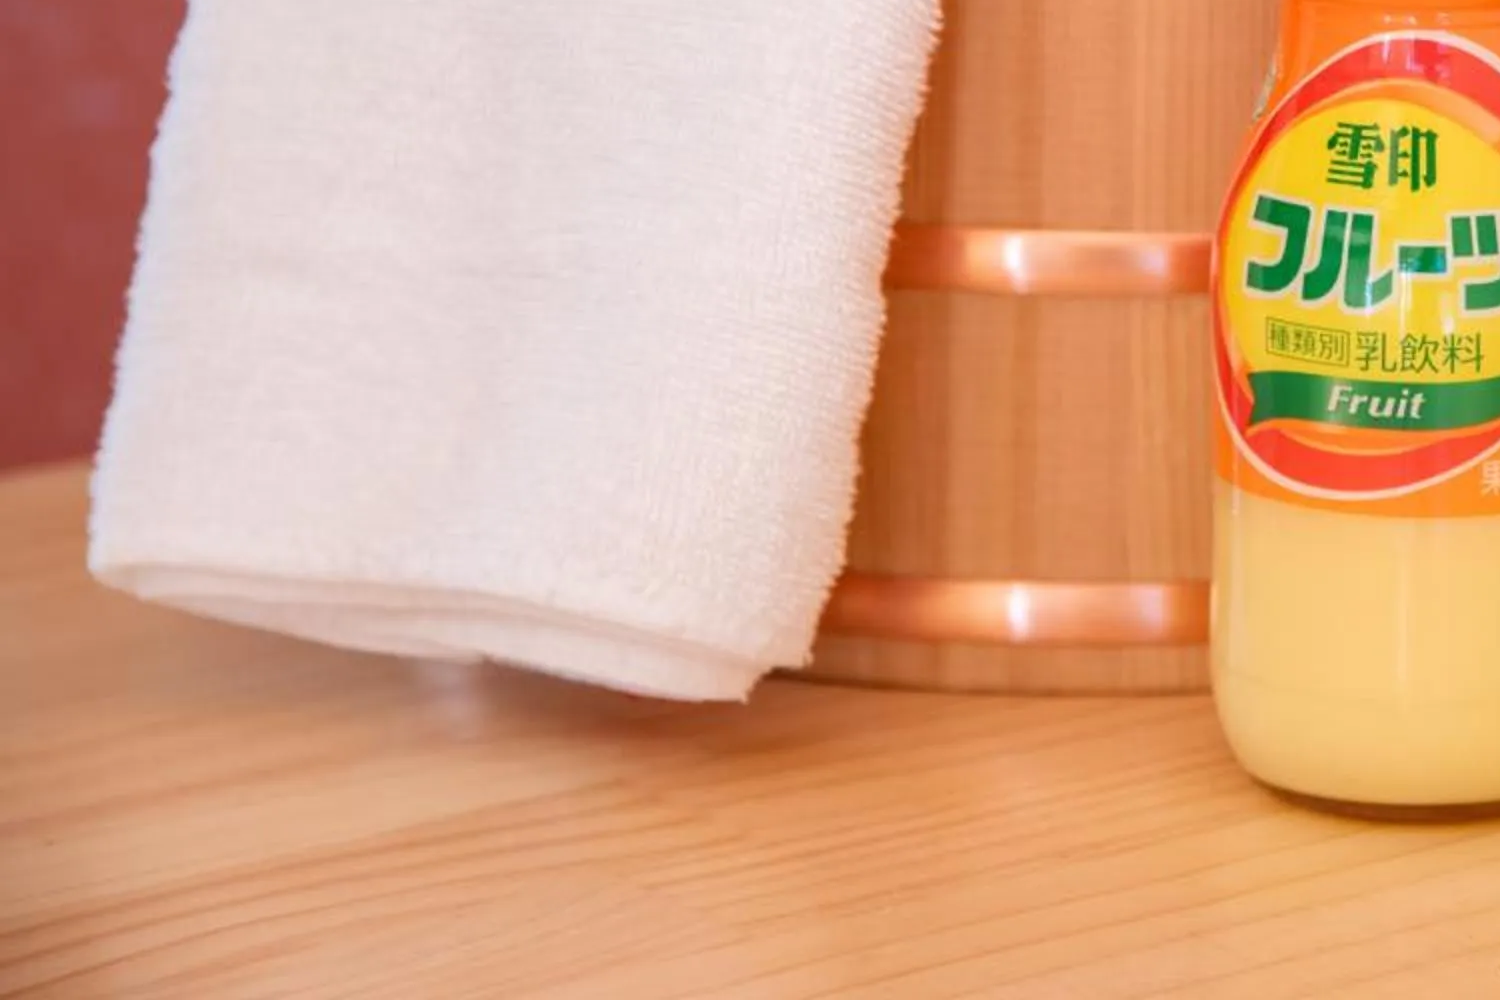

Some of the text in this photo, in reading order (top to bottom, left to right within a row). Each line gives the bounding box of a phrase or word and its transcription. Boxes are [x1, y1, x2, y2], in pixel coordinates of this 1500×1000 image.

[1325, 121, 1439, 194] 雪印
[1267, 322, 1485, 375] 種類別 乳飲料
[1327, 384, 1426, 421] Fruit
